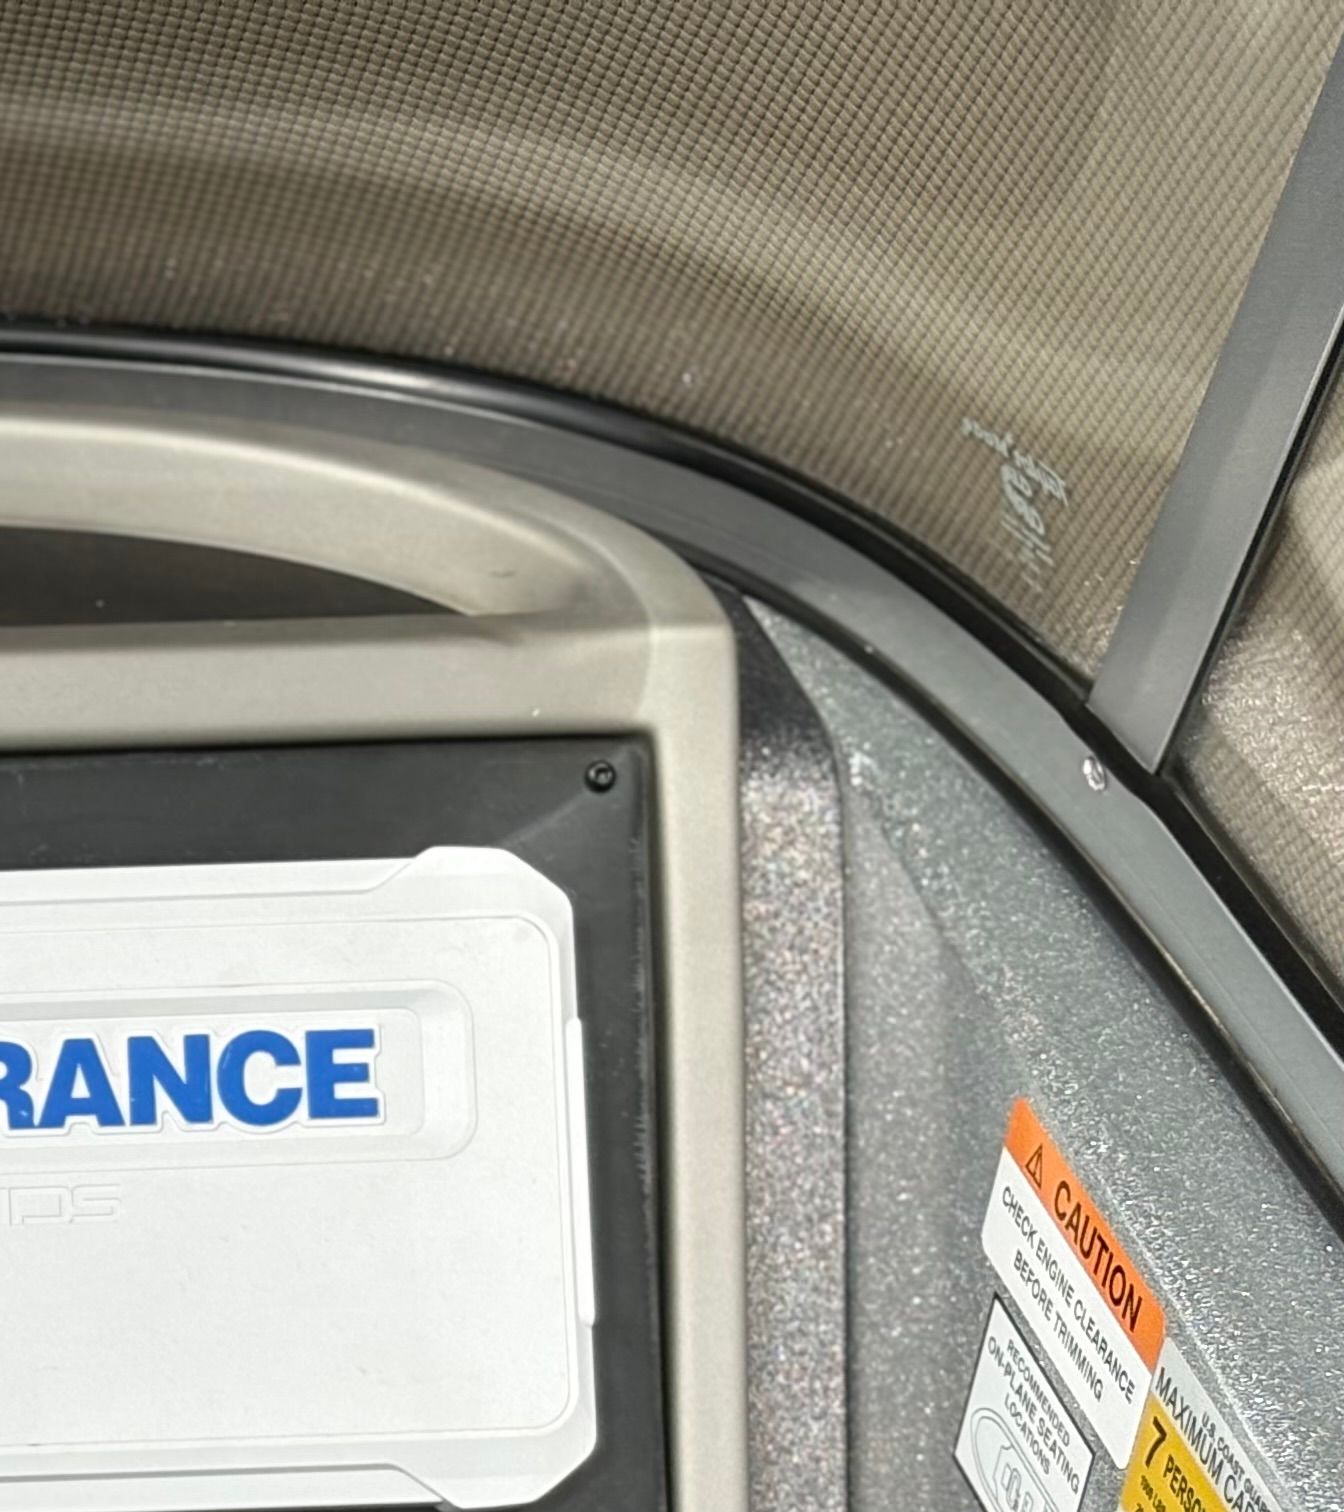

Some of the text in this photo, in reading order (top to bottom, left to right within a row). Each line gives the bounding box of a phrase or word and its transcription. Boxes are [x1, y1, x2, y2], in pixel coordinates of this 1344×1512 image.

[1003, 1186, 1134, 1404] CHECK ENGINE CLEARANCE
[1055, 1181, 1142, 1332] CAUTION
[1014, 1250, 1103, 1401] BEFORE TRIMMING
[988, 1336, 1079, 1494] ON-PLANE SEATING
[1005, 1393, 1050, 1474] LOCATIONS
[1007, 1339, 1069, 1446] RECOMMENDED
[1146, 1416, 1166, 1468] 7
[1156, 1367, 1224, 1484] MAXIMUM
[1218, 1437, 1244, 1480] COAST
